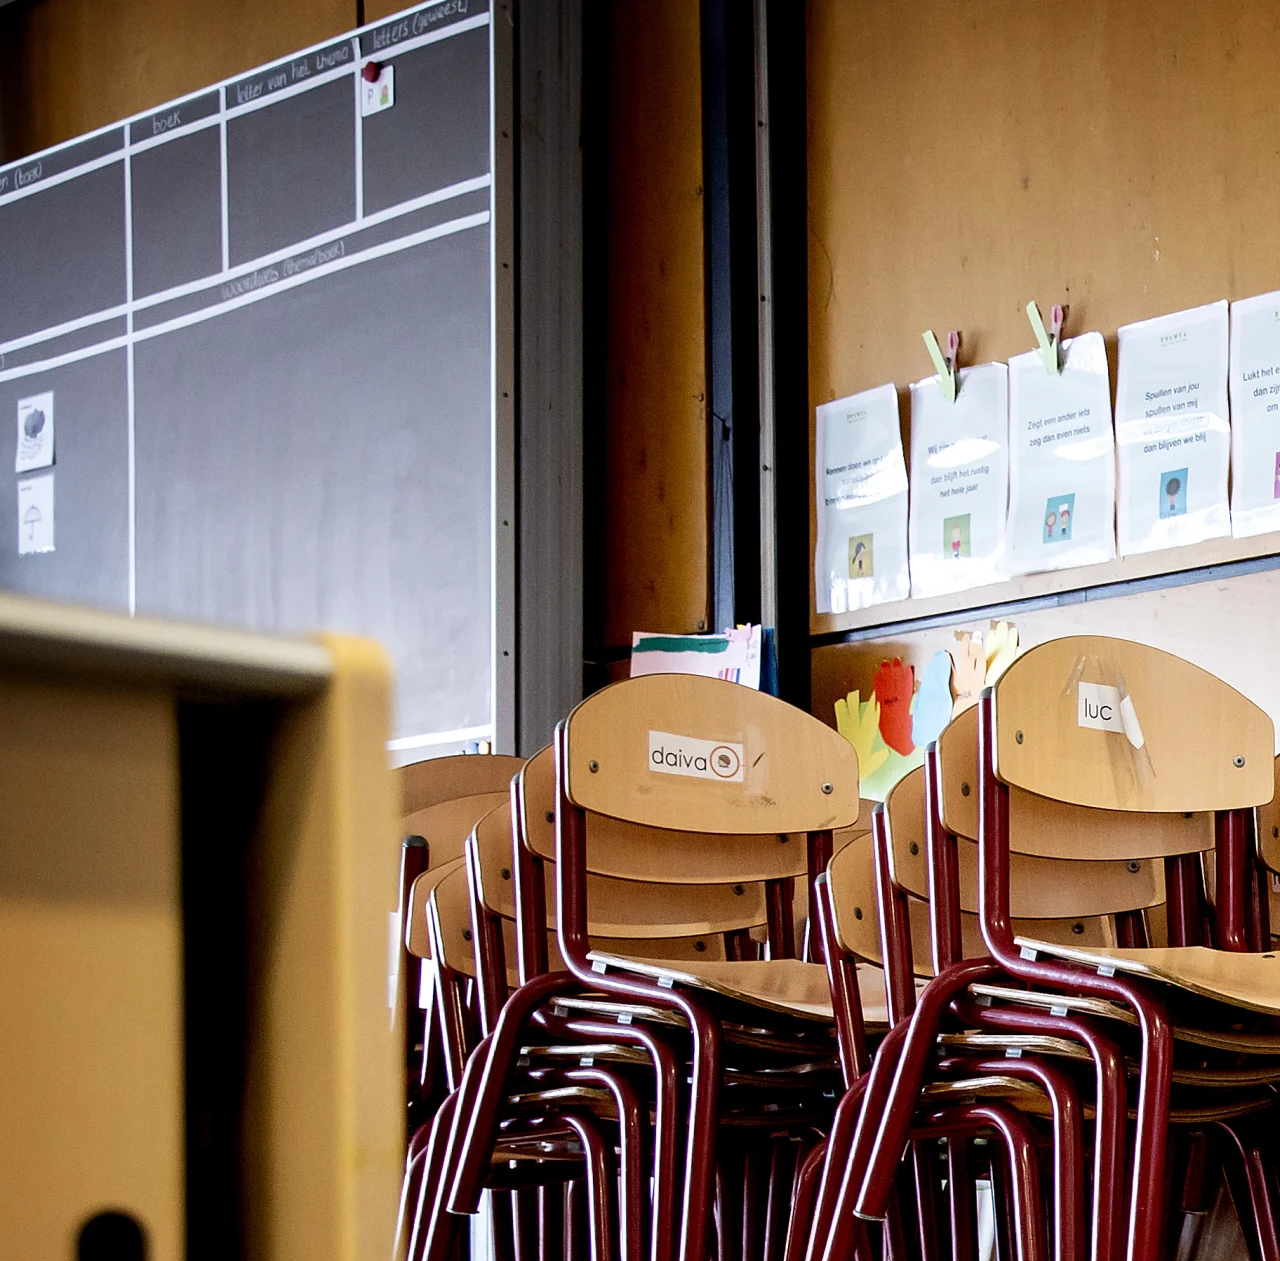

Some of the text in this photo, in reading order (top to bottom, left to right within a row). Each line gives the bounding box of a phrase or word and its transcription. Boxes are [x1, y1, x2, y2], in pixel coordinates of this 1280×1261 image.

[373, 20, 408, 49] letters
[236, 46, 349, 103] letter van het thema
[152, 110, 181, 135] boek
[1242, 369, 1260, 382] Lukt
[1261, 366, 1274, 377] het
[1144, 382, 1200, 402] Spullen van jou
[1253, 386, 1268, 397] dan
[1043, 417, 1056, 426] een
[1057, 412, 1077, 423] ander
[1078, 408, 1091, 418] iets
[1145, 397, 1199, 418] spullen van mij
[1266, 403, 1279, 412] om
[1029, 425, 1091, 447] zeg dan even niets
[1143, 430, 1207, 453] dan blijven we blij
[930, 475, 942, 485] dan
[959, 468, 970, 478] het
[970, 465, 990, 476] rustig
[939, 489, 950, 498] het
[965, 483, 979, 495] jaar
[1084, 697, 1113, 721] luc
[651, 746, 708, 771] daiva
